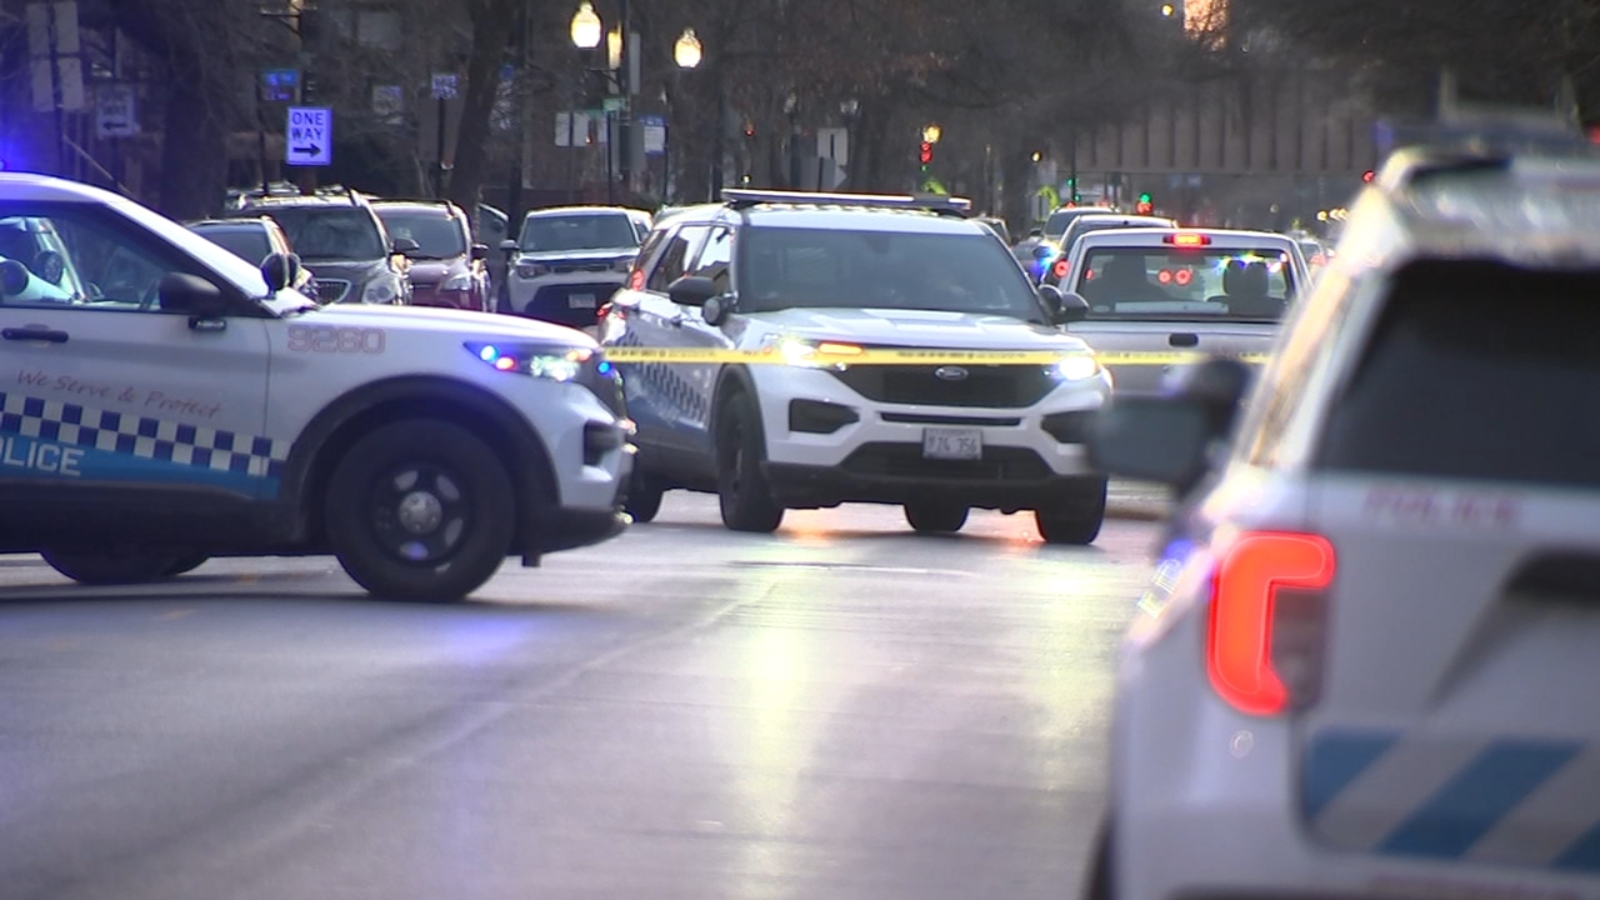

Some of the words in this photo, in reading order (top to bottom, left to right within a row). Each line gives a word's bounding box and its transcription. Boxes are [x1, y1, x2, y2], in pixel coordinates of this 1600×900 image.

[291, 112, 324, 126] ONE
[291, 128, 324, 141] WAY
[287, 323, 386, 354] 9260
[17, 369, 48, 387] We
[52, 375, 111, 398] Serve
[117, 386, 135, 404] &
[144, 390, 223, 419] Protect
[0, 435, 86, 476] LICE
